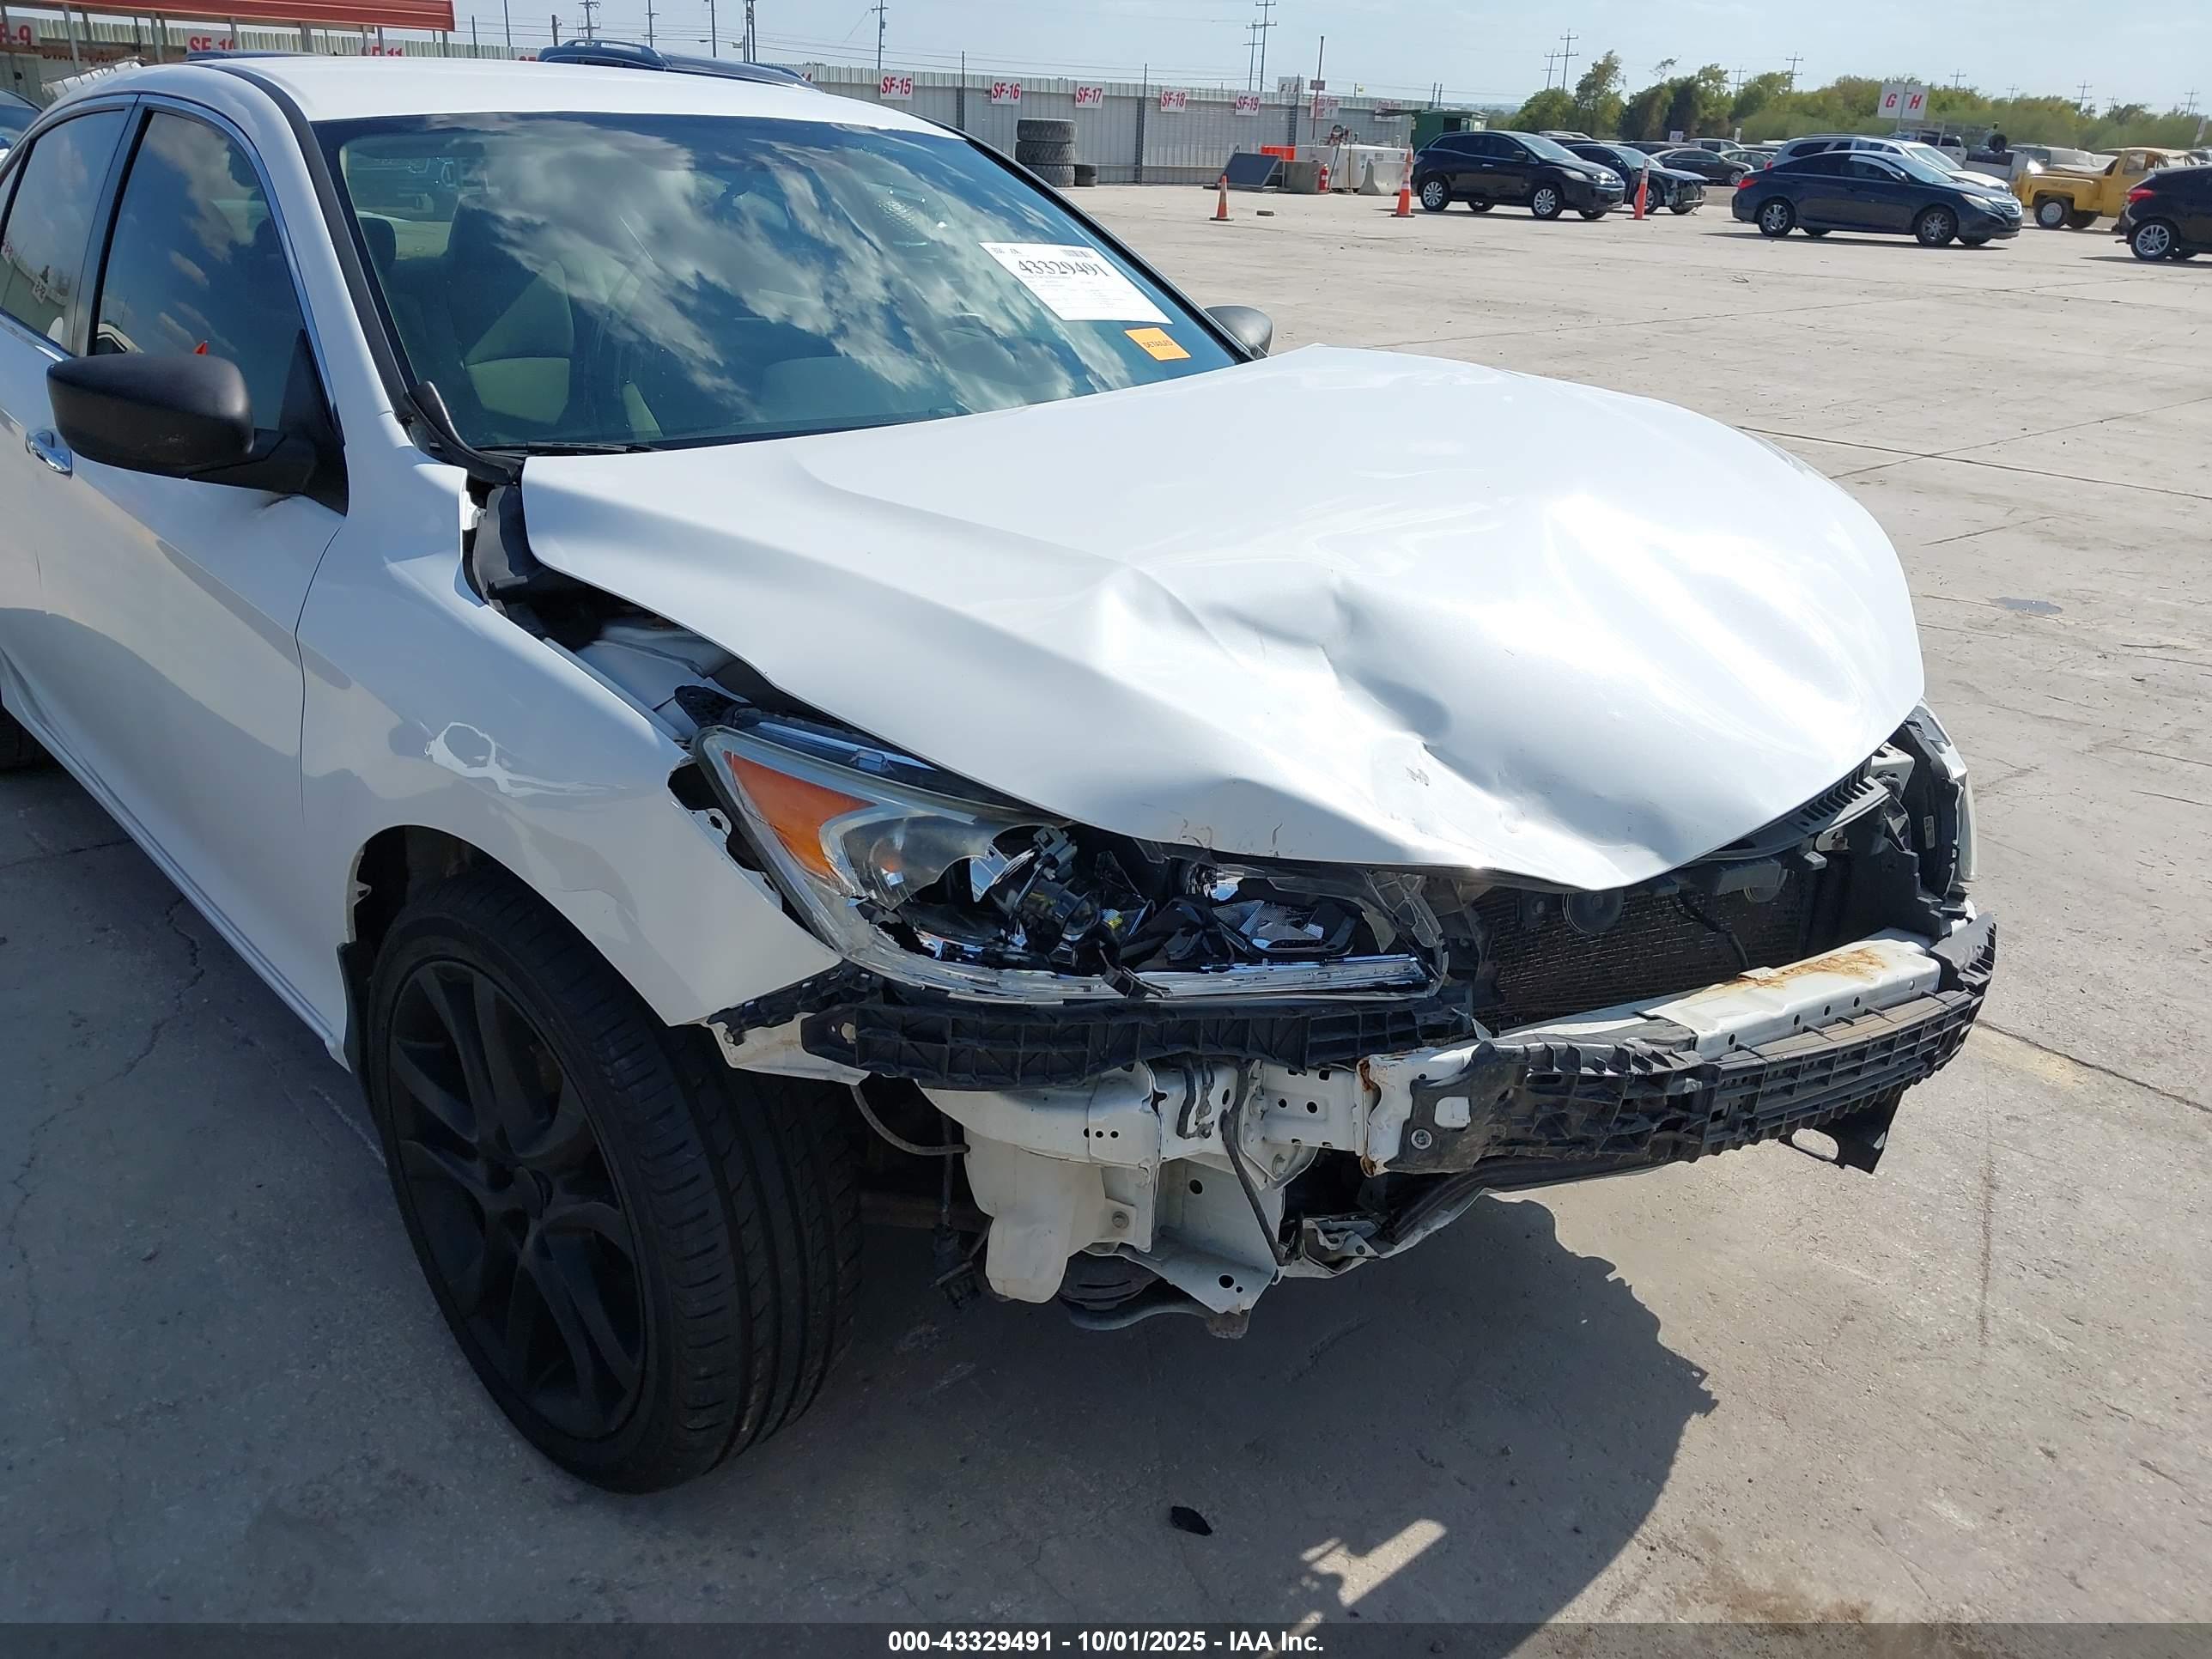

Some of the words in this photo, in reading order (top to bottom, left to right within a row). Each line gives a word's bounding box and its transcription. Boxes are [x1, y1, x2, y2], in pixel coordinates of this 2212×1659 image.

[881, 76, 912, 94] SF-15
[992, 82, 1021, 100] SF-16
[1076, 87, 1103, 104] SF-17
[1161, 91, 1186, 108] SF-18
[1236, 95, 1259, 112] SF-19
[1885, 93, 1898, 108] G
[1908, 94, 1923, 109] H
[1018, 260, 1111, 276] 43329491
